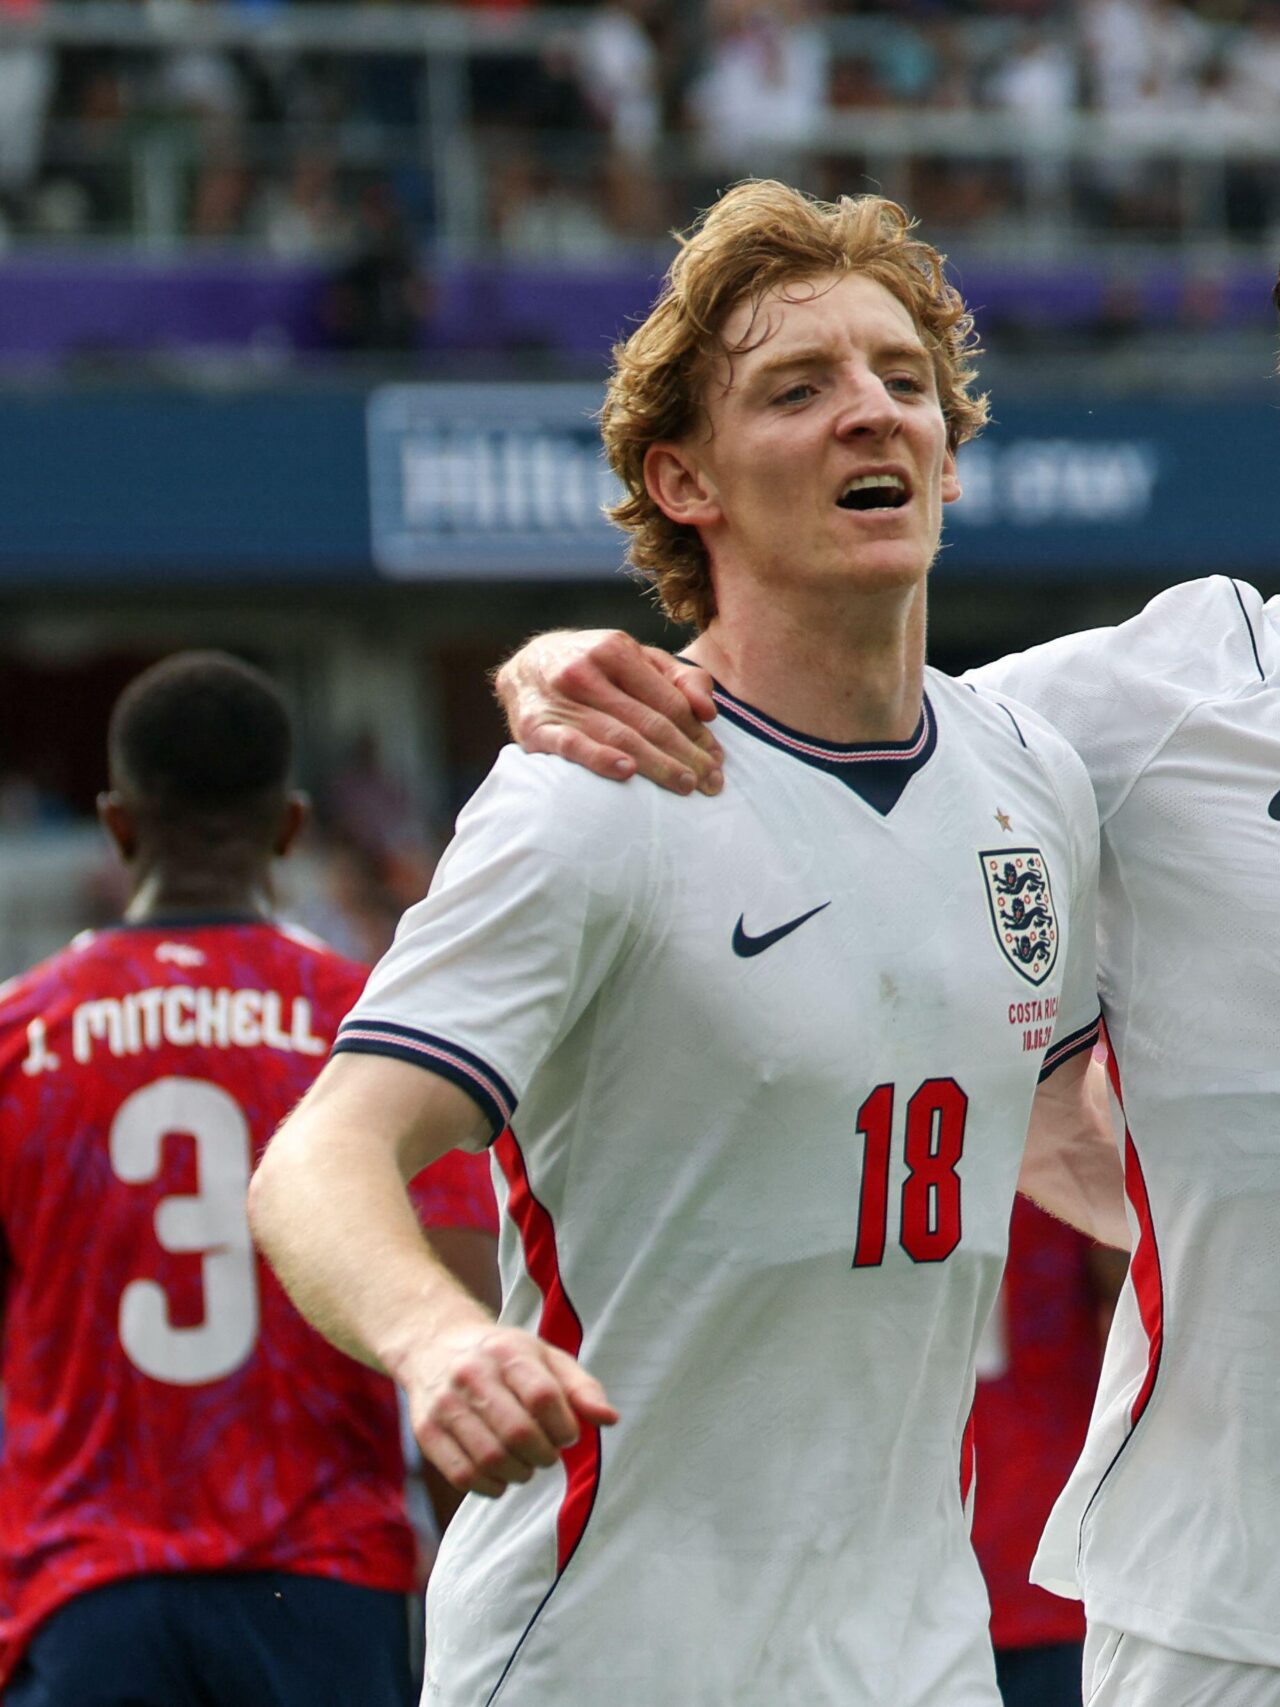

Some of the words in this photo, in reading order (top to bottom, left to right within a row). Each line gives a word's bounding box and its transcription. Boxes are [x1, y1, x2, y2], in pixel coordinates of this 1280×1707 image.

[22, 1017, 60, 1076] J.
[73, 986, 326, 1064] MITCHELL
[1008, 999, 1043, 1024] COSTA
[109, 1076, 260, 1386] 3
[851, 1077, 969, 1269] 18
